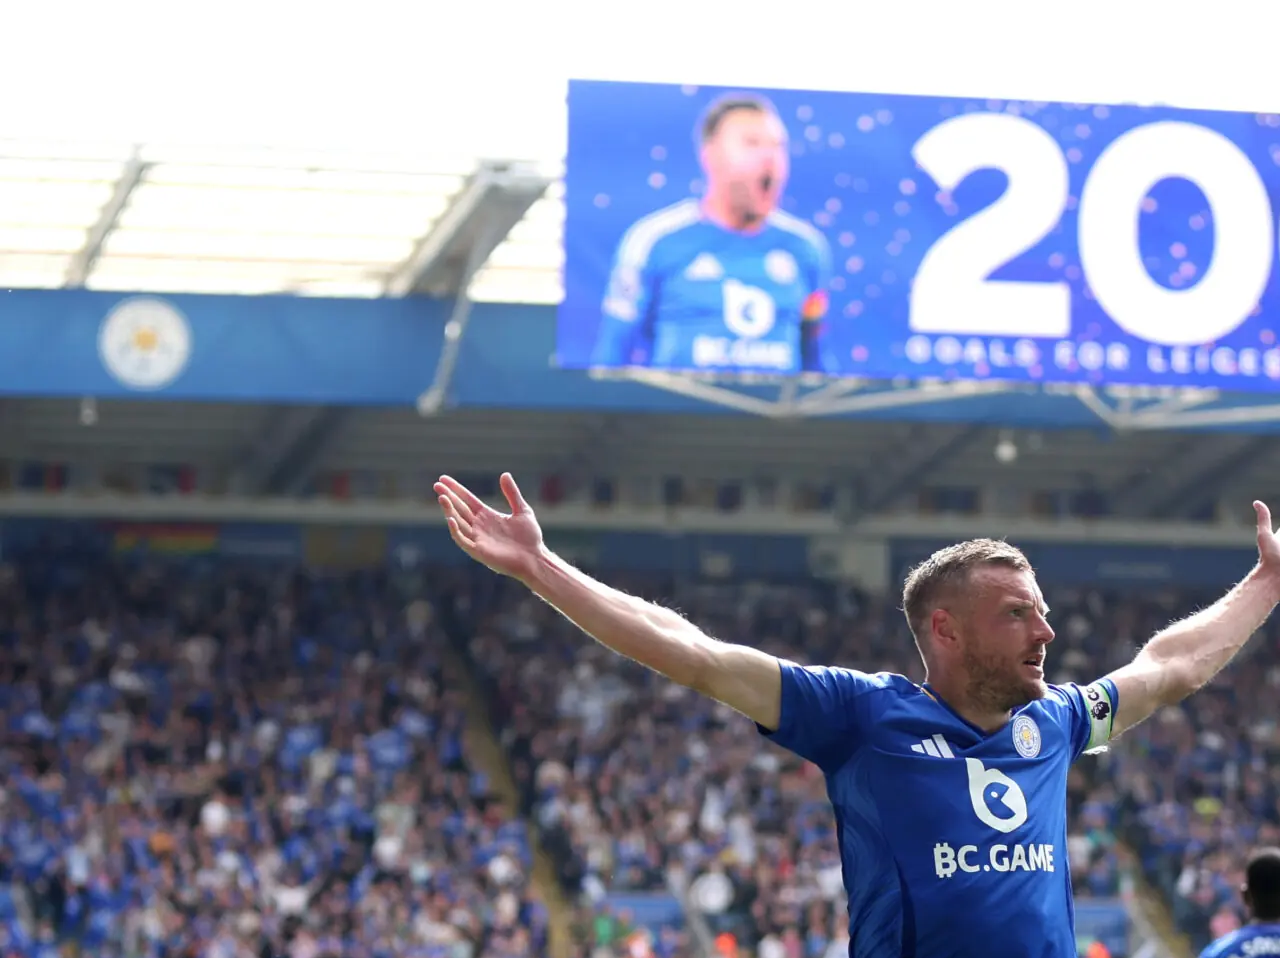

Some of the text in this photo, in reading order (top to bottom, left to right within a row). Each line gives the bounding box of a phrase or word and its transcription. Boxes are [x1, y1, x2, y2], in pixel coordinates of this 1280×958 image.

[905, 334, 1038, 368] GOALS
[1053, 340, 1132, 371] FOR
[934, 842, 1054, 878] BC.GAME
